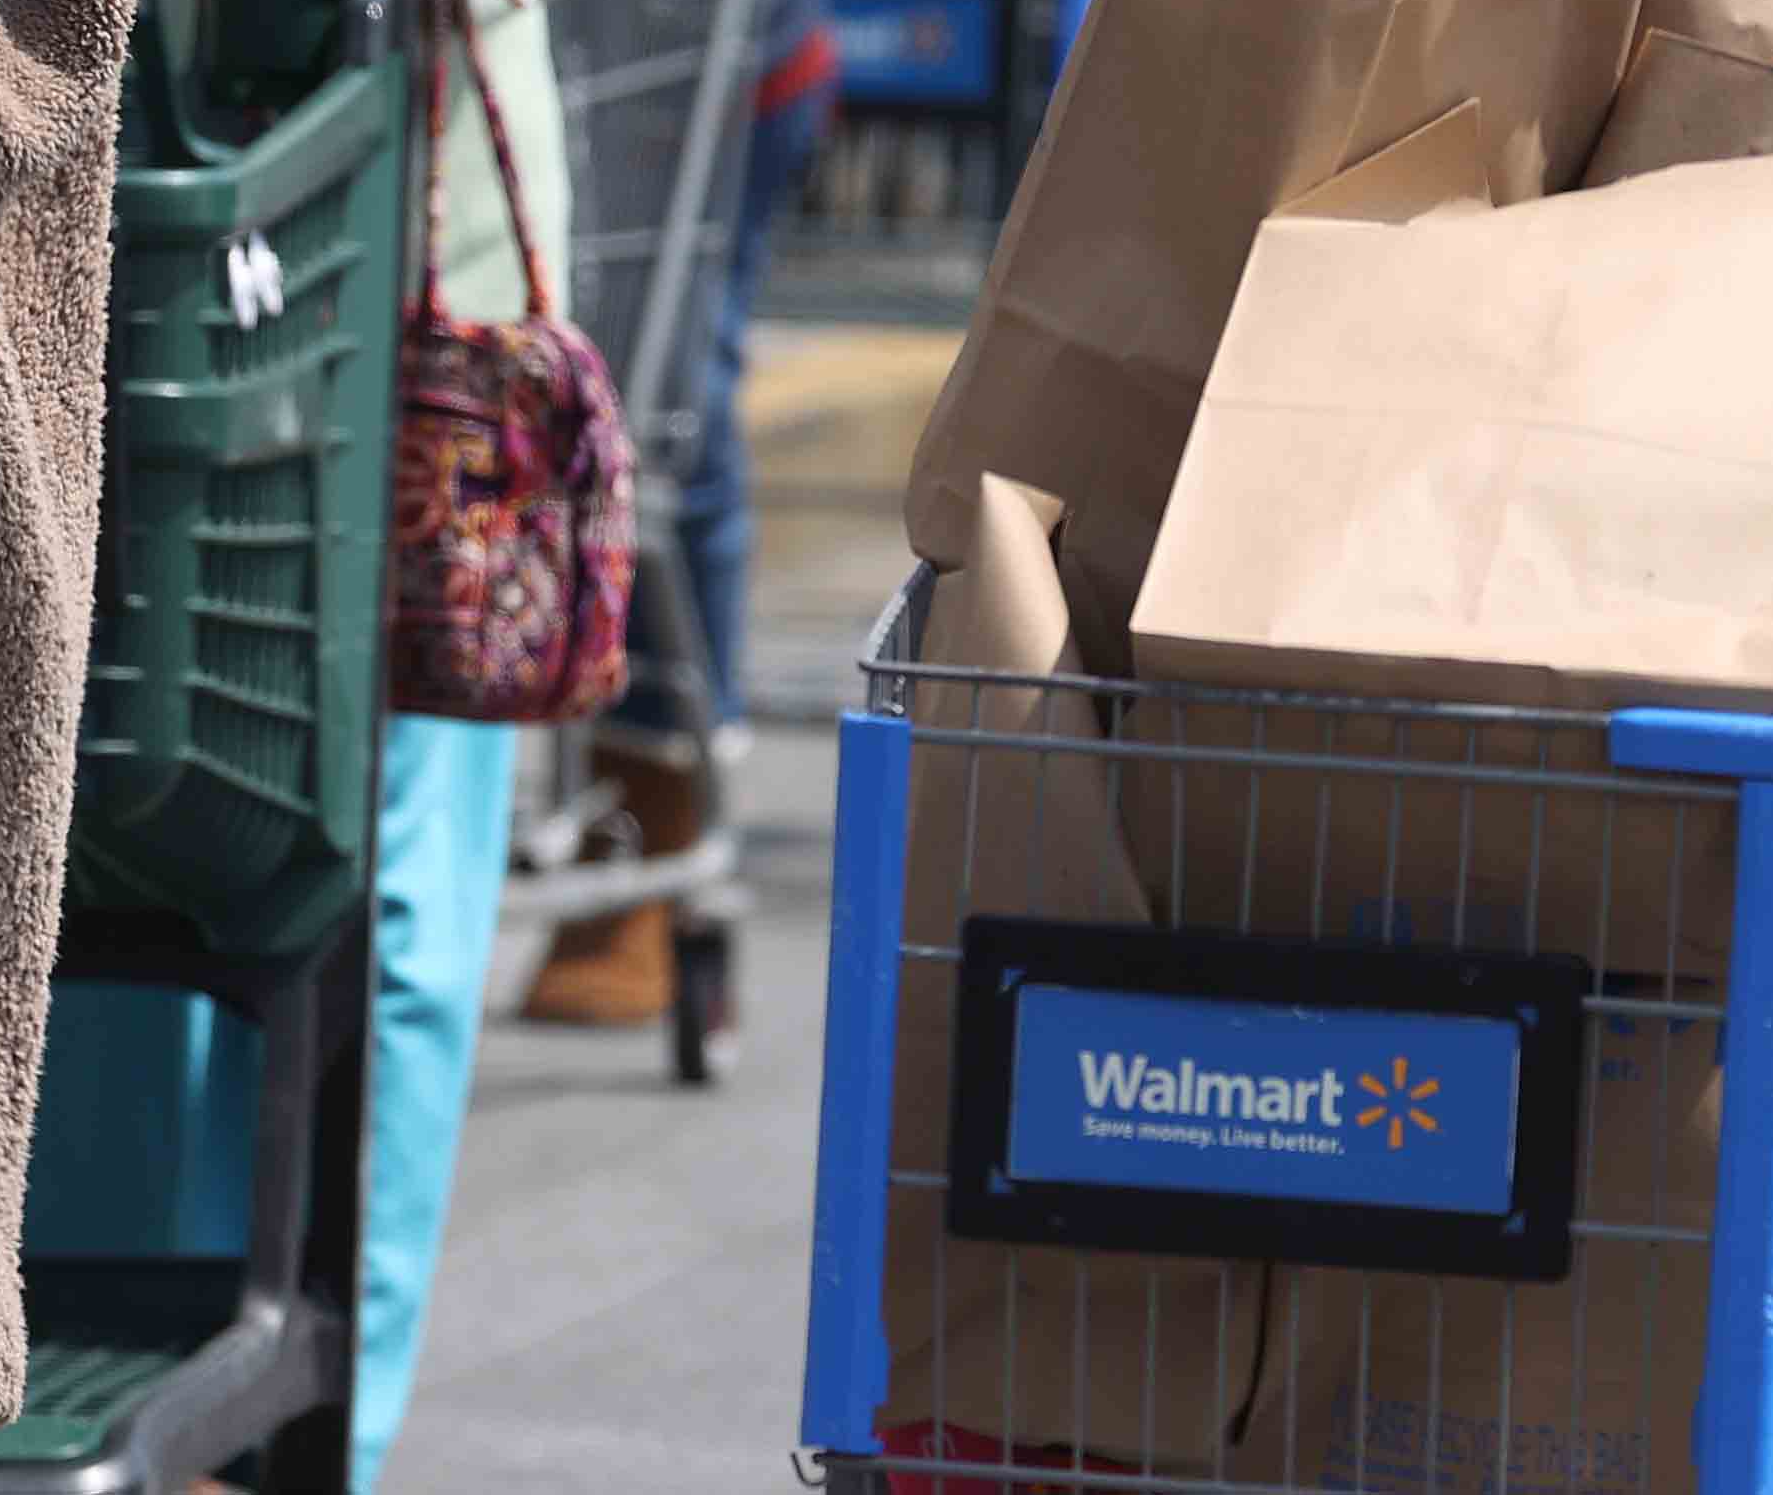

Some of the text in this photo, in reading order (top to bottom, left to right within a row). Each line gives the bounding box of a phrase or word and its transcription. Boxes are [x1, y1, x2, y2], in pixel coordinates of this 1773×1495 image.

[1079, 1050, 1344, 1127] Walmart
[1083, 1113, 1345, 1155] Save money. Live better.
